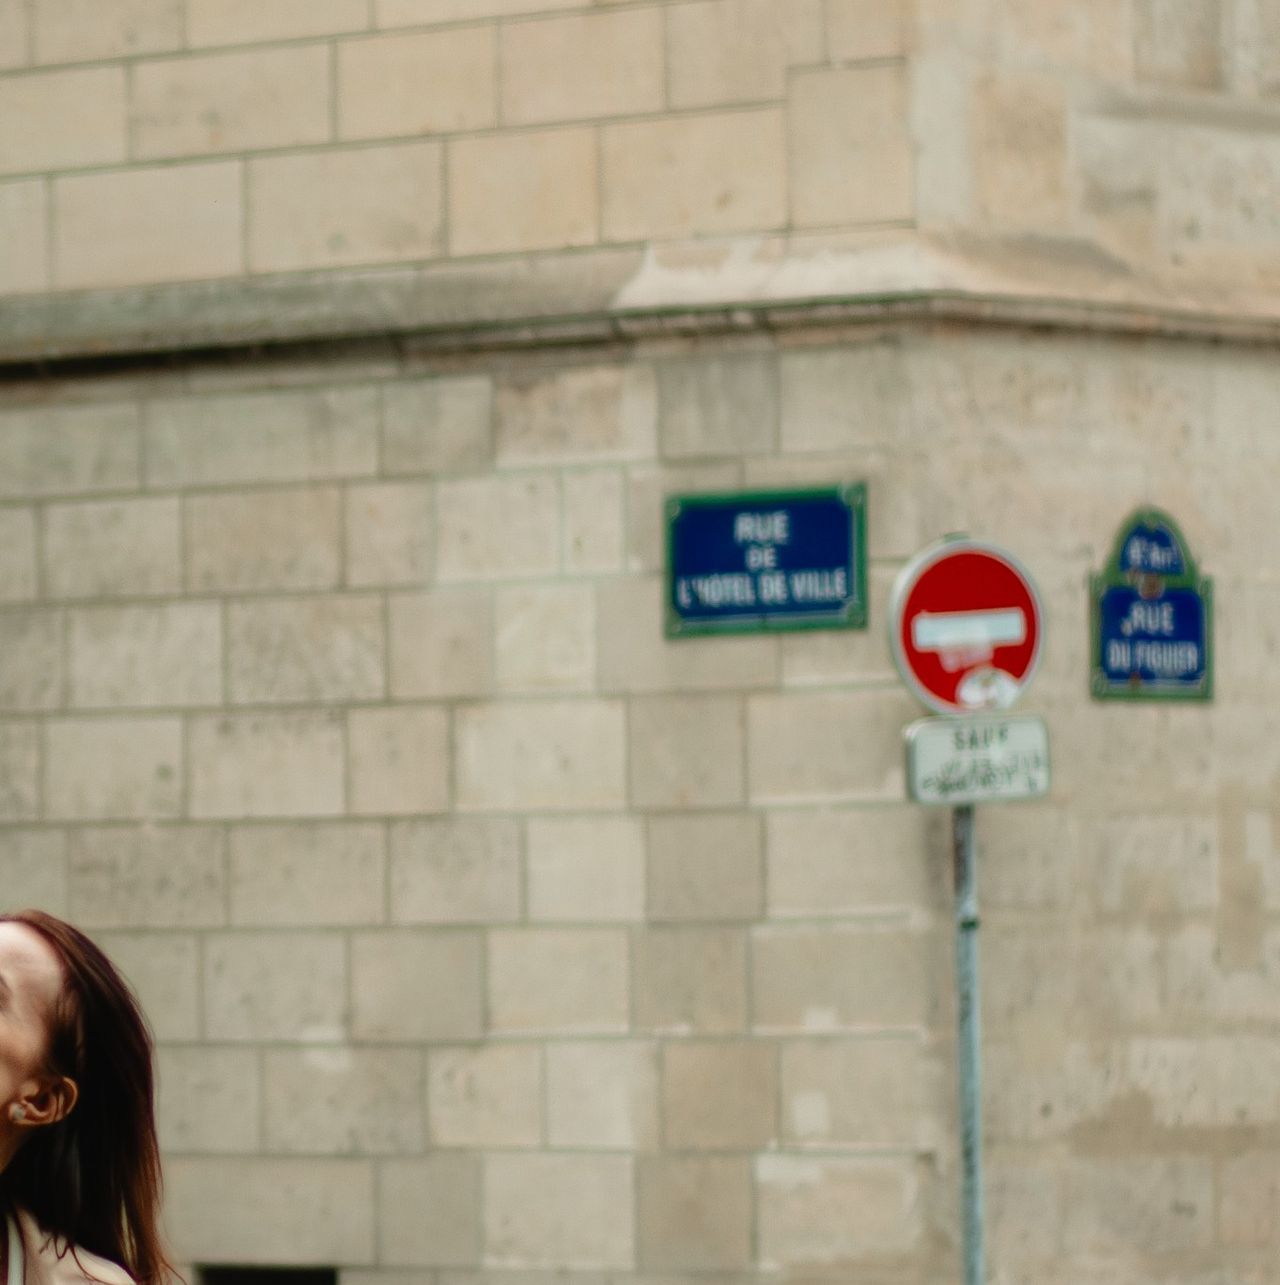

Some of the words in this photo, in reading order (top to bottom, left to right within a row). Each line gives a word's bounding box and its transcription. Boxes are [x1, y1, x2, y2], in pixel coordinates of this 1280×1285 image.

[735, 511, 789, 543] RUE
[747, 546, 778, 572] DE
[760, 572, 788, 604] DE
[792, 568, 846, 601] VILLE
[1132, 601, 1174, 633] RUE
[1108, 640, 1131, 671] DU
[1135, 641, 1198, 672] FIGUIER
